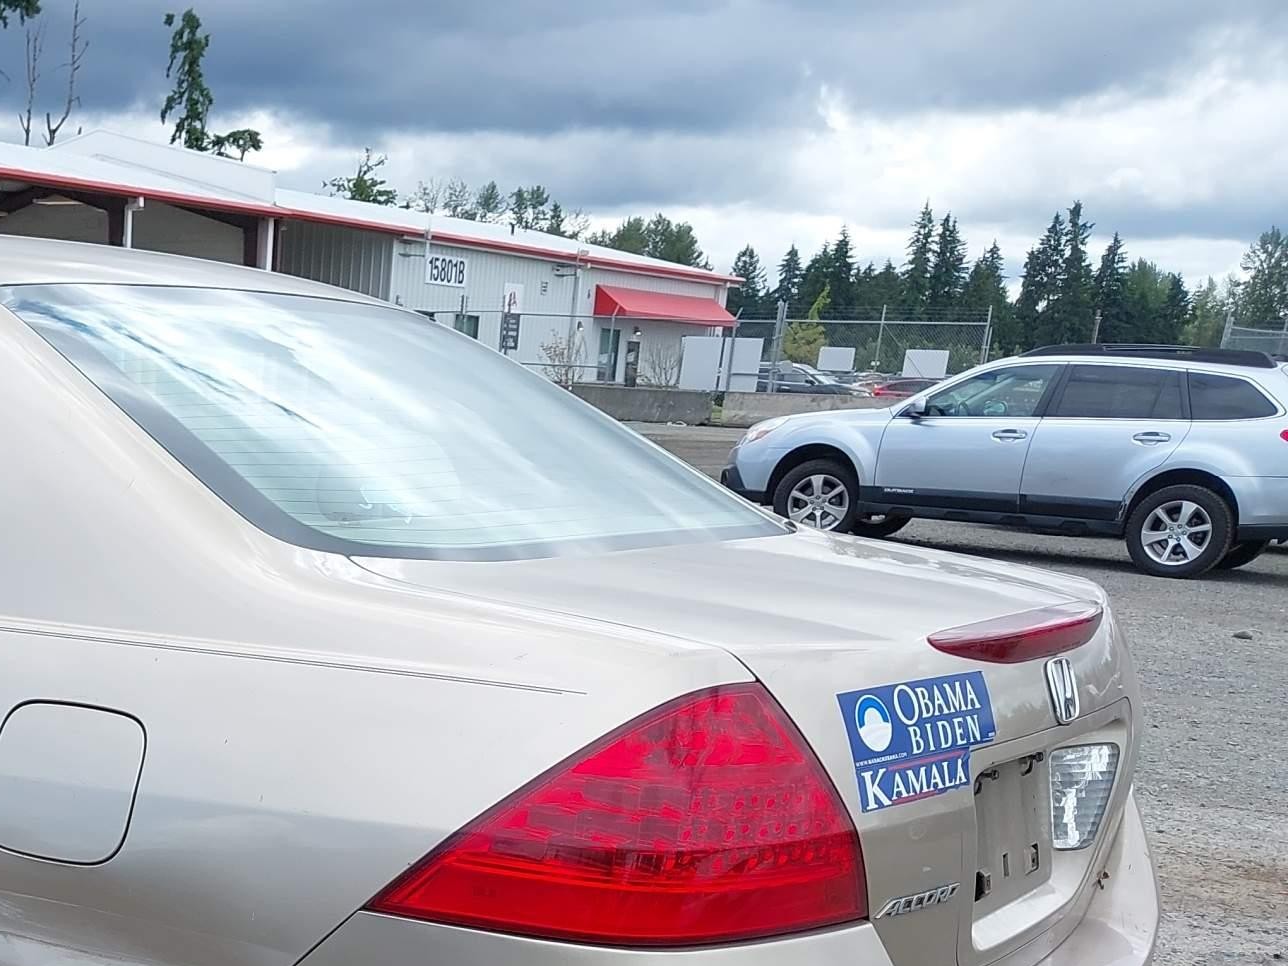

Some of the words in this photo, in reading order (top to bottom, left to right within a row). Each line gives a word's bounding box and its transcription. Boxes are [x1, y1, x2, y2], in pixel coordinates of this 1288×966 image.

[428, 256, 465, 284] 15801B
[893, 679, 981, 725] OBAMA
[907, 714, 981, 755] BIDEN
[861, 758, 967, 810] KAMALA
[874, 882, 960, 919] ACCORD
